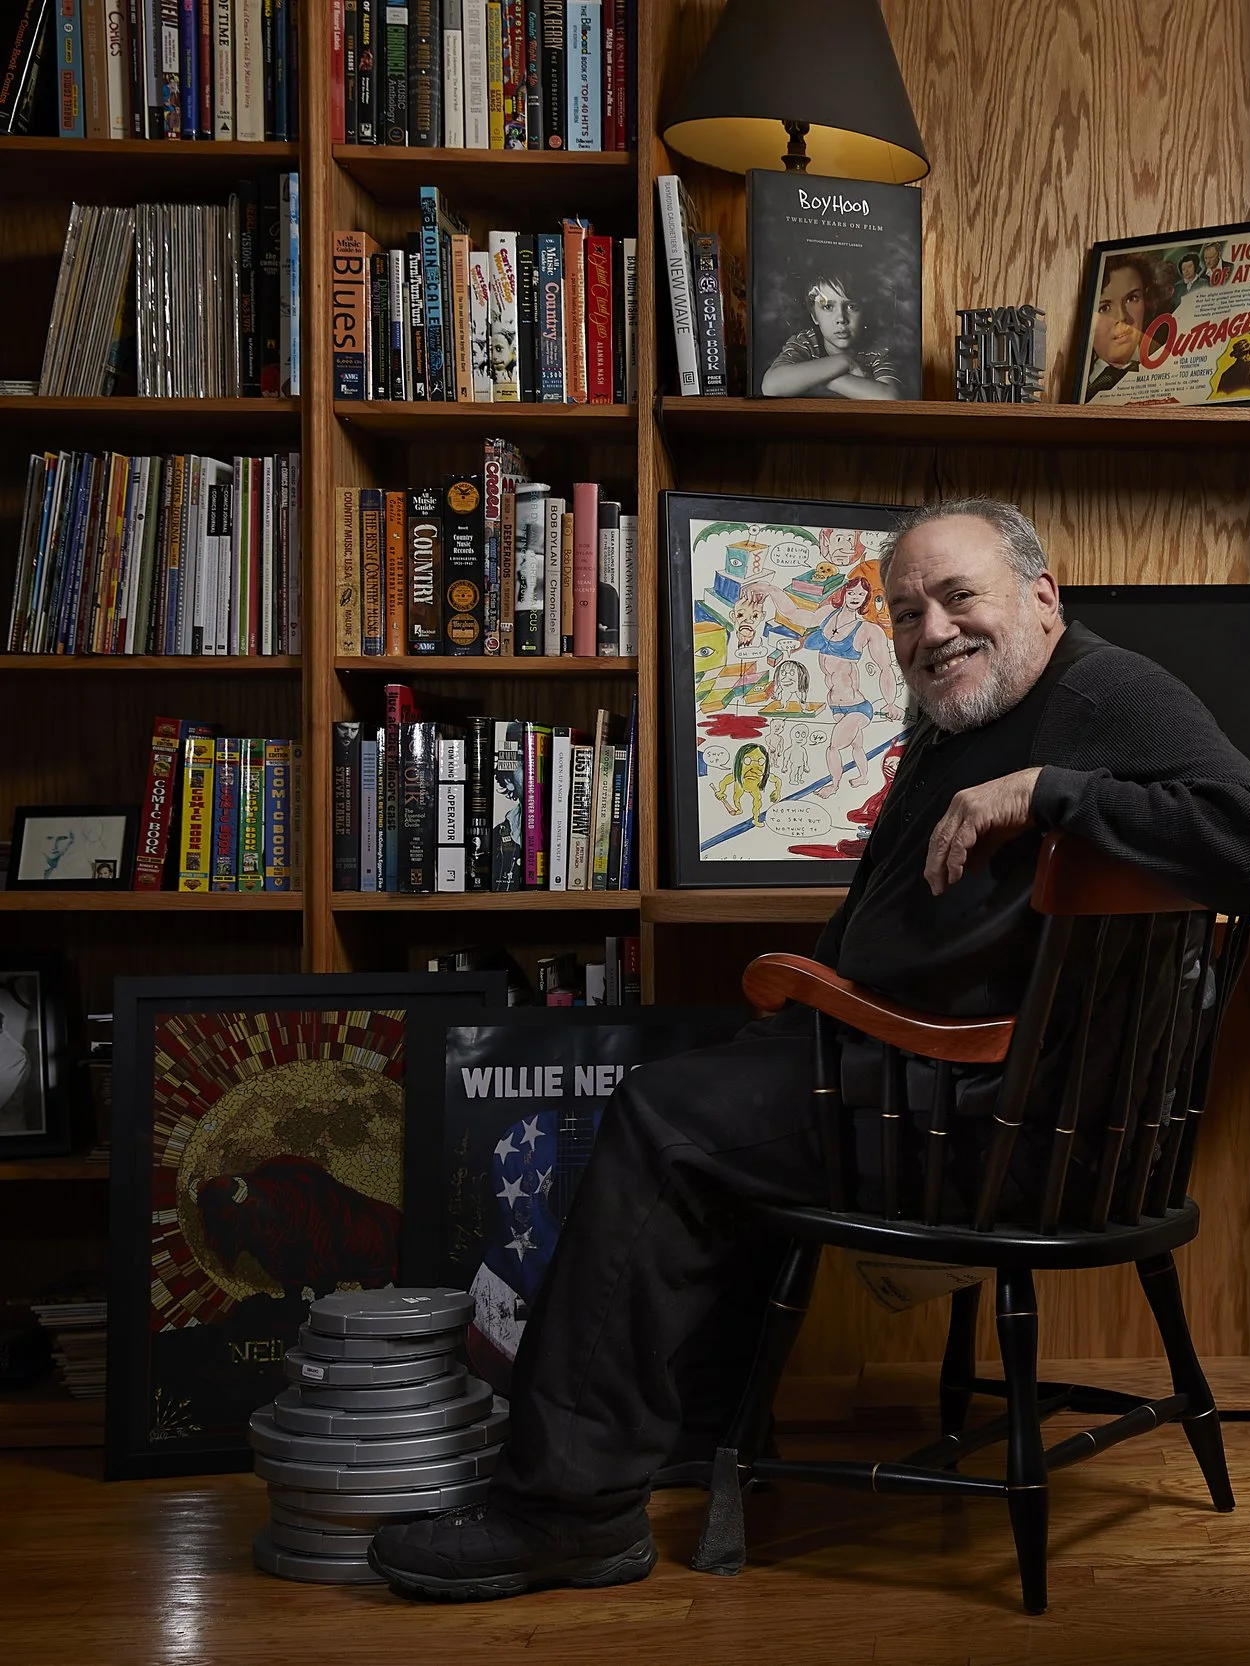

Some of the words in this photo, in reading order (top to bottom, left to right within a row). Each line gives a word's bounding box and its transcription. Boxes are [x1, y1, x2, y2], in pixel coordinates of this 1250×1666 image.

[219, 14, 229, 46] TIME
[543, 19, 563, 50] BERRY
[581, 18, 591, 54] Billboard
[386, 26, 405, 77] CHRONICLE
[387, 79, 398, 123] Anthology
[551, 68, 559, 131] AUTOBIOGRAPHY
[582, 104, 588, 113] 40
[664, 181, 673, 211] RAYMOND
[246, 203, 257, 232] REBEL
[786, 216, 819, 225] TWELVE
[821, 220, 847, 228] YEARS
[242, 231, 253, 269] VISIONS
[337, 239, 362, 248] Music
[425, 226, 438, 269] JOHN
[500, 248, 513, 274] Can't
[508, 273, 516, 296] Stop
[546, 246, 557, 276] Music
[626, 256, 637, 271] BAD
[670, 257, 684, 291] NEW
[1210, 266, 1231, 287] OF
[475, 264, 485, 284] Can't
[480, 284, 489, 302] Stop
[493, 252, 507, 282] Won't
[501, 282, 514, 304] Stop
[627, 273, 638, 297] MOON
[702, 279, 713, 288] 45
[334, 256, 363, 348] Blues
[379, 280, 388, 313] DREAM
[426, 281, 440, 326] CALE
[542, 281, 560, 341] Country
[242, 293, 252, 333] 1963-1975
[628, 299, 637, 326] RISING
[674, 294, 690, 334] WAVE
[704, 298, 717, 337] COMIC
[956, 304, 1045, 336] TEXAS
[571, 322, 579, 343] Country
[596, 341, 604, 367] ALANNA
[706, 340, 720, 370] BOOK
[955, 332, 1046, 368] FILM
[597, 368, 605, 385] NASH
[1151, 373, 1171, 381] POWERS
[1189, 369, 1213, 377] ANDREWS
[172, 468, 182, 502] COMICS
[281, 467, 289, 486] COMICS
[281, 487, 289, 508] JOURNAL
[344, 491, 353, 528] COUNTRY
[412, 496, 437, 505] Music
[170, 504, 181, 544] JOURNAL
[365, 512, 377, 529] THE
[550, 505, 558, 528] BOB
[343, 529, 353, 557] MUSIC,
[366, 532, 377, 552] BEST
[502, 524, 512, 579] DESPERADOS
[550, 531, 559, 566] DYLAN
[563, 549, 572, 565] Bob
[625, 538, 634, 568] DYLAN
[344, 558, 353, 580] U.S.A.
[413, 524, 438, 604] COUNTRY
[563, 566, 572, 588] Dylan
[549, 579, 558, 633] Chronicles
[626, 585, 634, 616] DYLAN
[366, 607, 378, 636] MUSIC
[387, 692, 399, 712] live
[388, 716, 398, 728] at
[388, 732, 399, 751] the
[574, 749, 592, 780] LOST
[602, 749, 610, 778] WOODY
[271, 766, 286, 821] COMIC
[335, 766, 345, 795] STEVE
[151, 779, 165, 820] COMIC
[601, 780, 609, 818] GUTHRIE
[613, 792, 622, 819] HAGGARD
[335, 797, 345, 835] EARLE
[388, 804, 399, 831] east
[447, 794, 455, 841] OPERATOR
[144, 822, 161, 855] BOOK
[272, 824, 285, 866] BOOK
[461, 1064, 563, 1099] WILLIE
